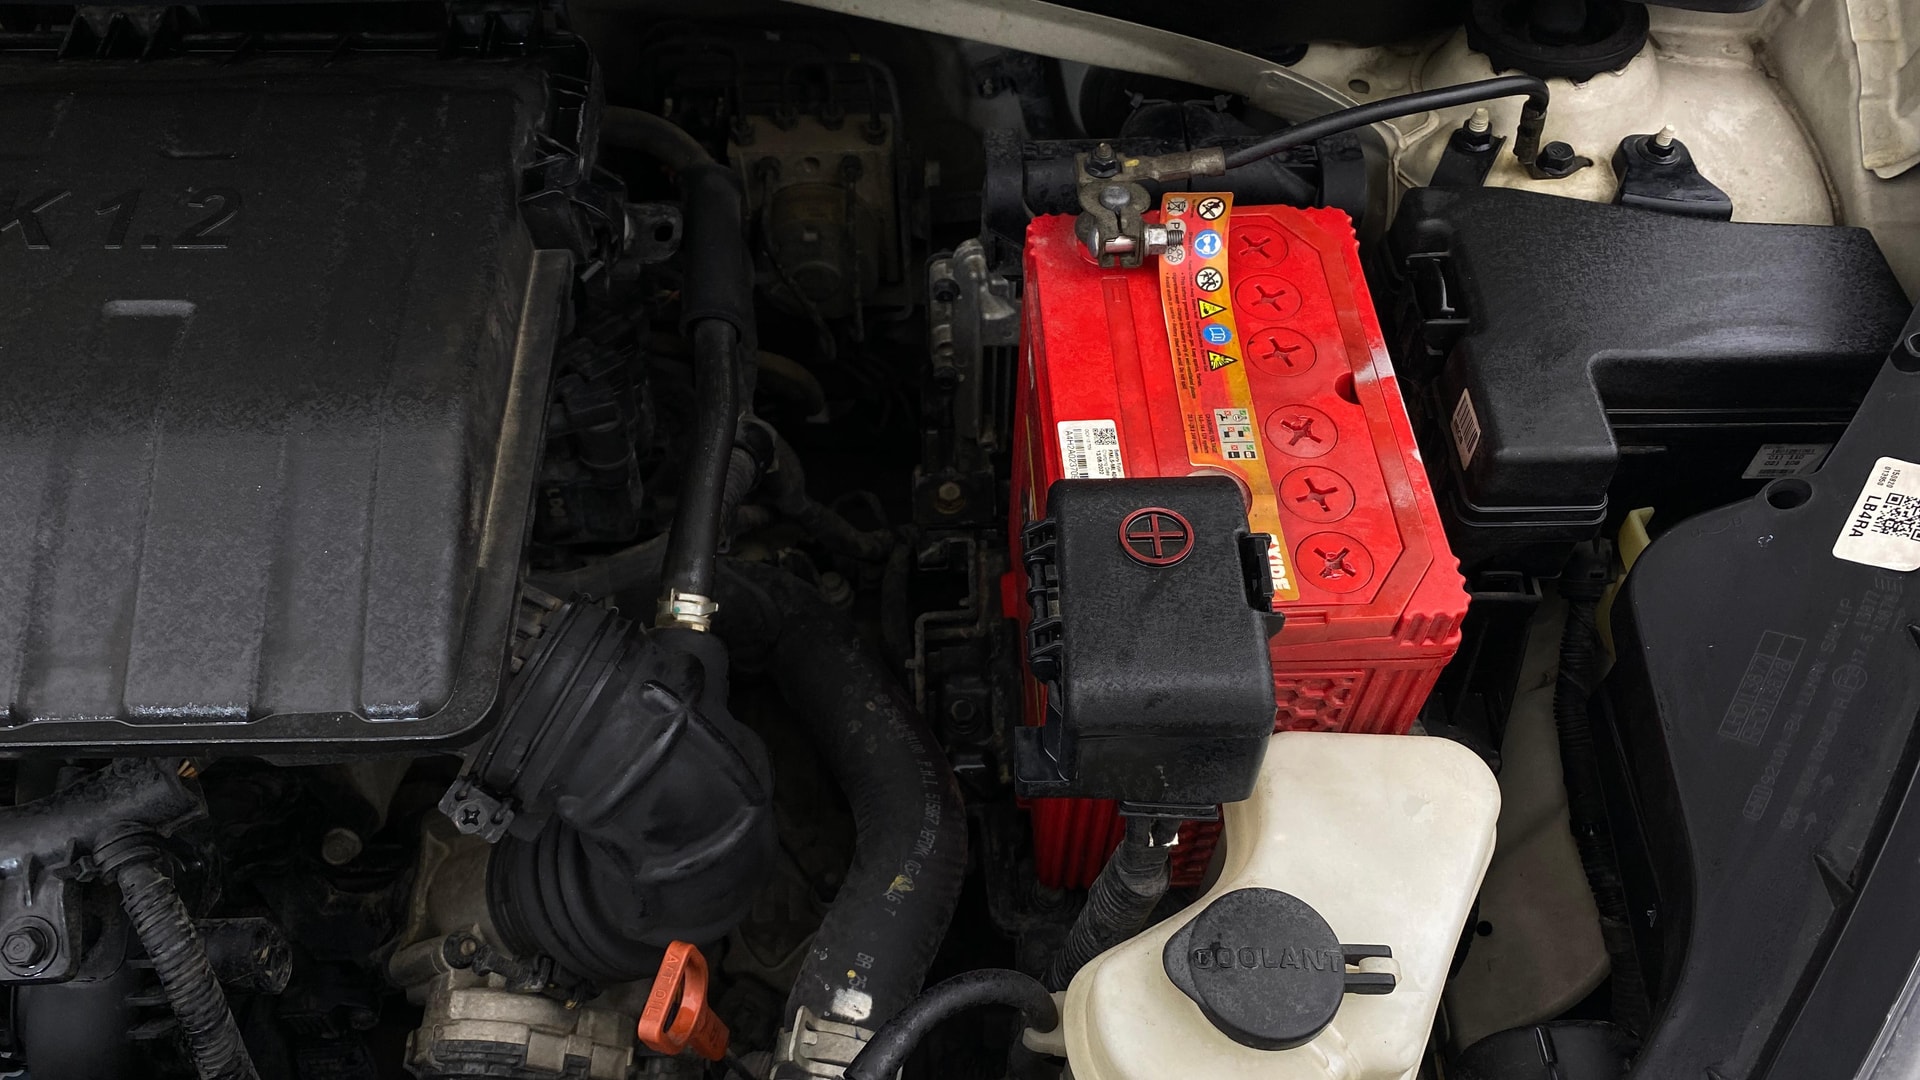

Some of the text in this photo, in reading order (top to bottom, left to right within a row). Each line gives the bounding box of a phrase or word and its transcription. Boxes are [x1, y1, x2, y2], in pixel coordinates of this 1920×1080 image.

[96, 188, 242, 250] 1.2
[1849, 495, 1882, 537] LB4RA
[1192, 946, 1344, 973] COOLANT
